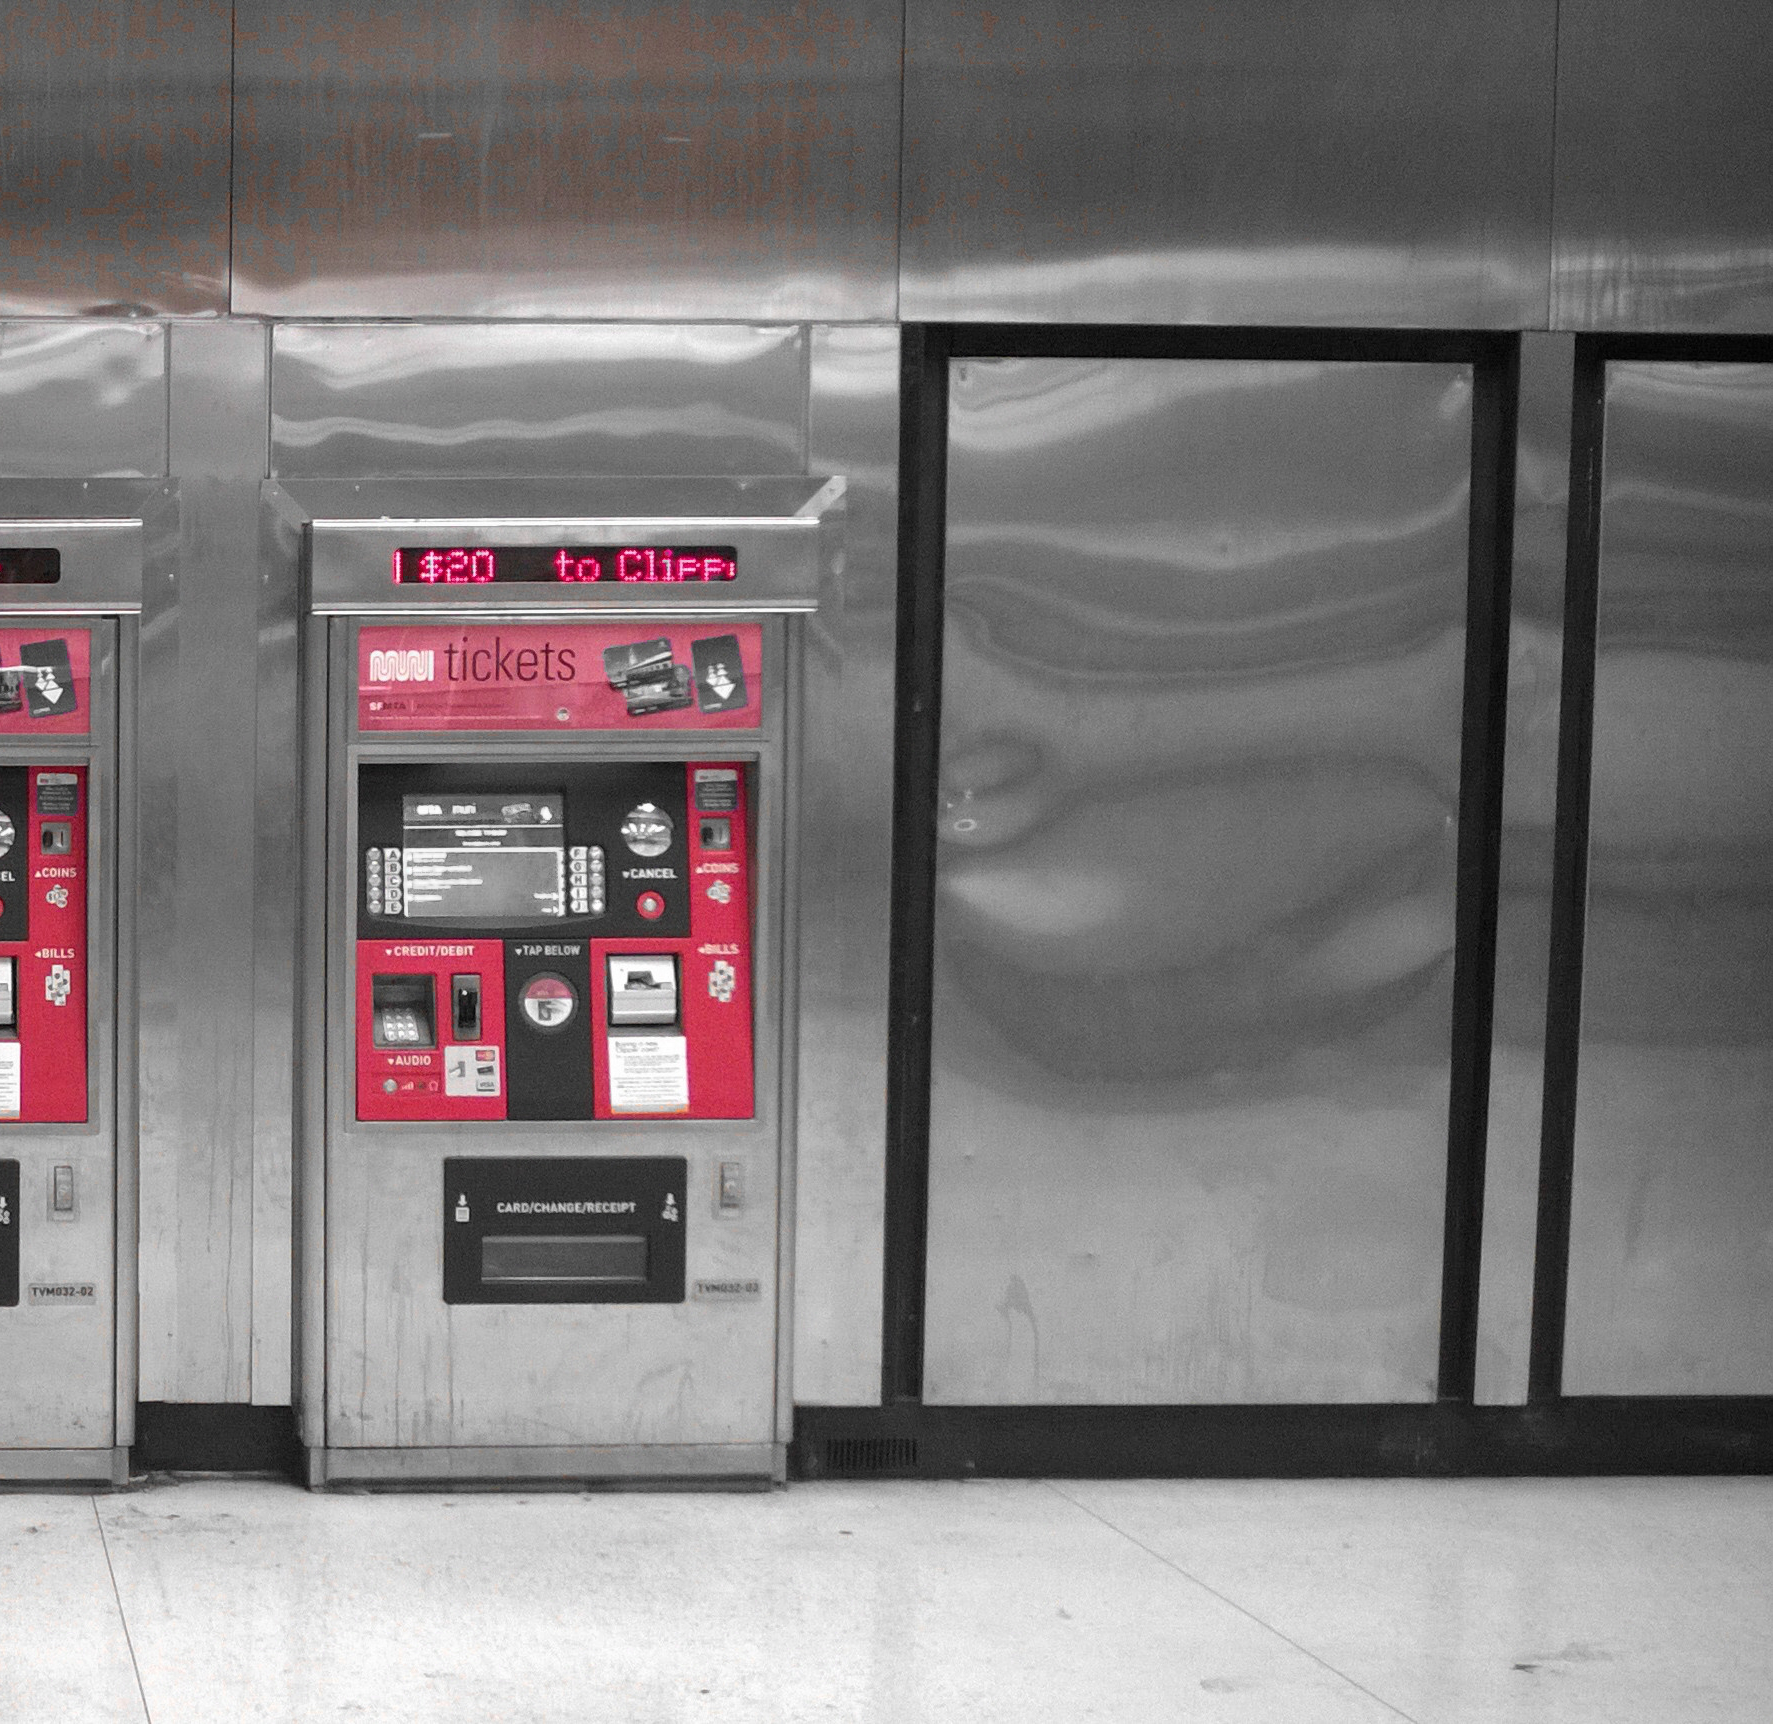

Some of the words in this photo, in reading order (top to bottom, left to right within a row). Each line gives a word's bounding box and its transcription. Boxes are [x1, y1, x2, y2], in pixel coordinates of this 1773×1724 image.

[419, 549, 496, 584] $20
[555, 548, 601, 583] to
[617, 548, 736, 583] Clipp
[443, 636, 577, 683] tickets
[42, 867, 77, 879] COINS
[630, 868, 678, 879] CANCEL
[42, 948, 75, 959] BILLS
[394, 945, 475, 957] CREDIT/DEBIT
[523, 945, 542, 956] TAP
[544, 945, 580, 956] BELOW
[395, 1056, 432, 1066] AUDIO
[496, 1202, 637, 1214] CARD/CHANGE/RECEIPT
[31, 1286, 94, 1298] TVM032-02
